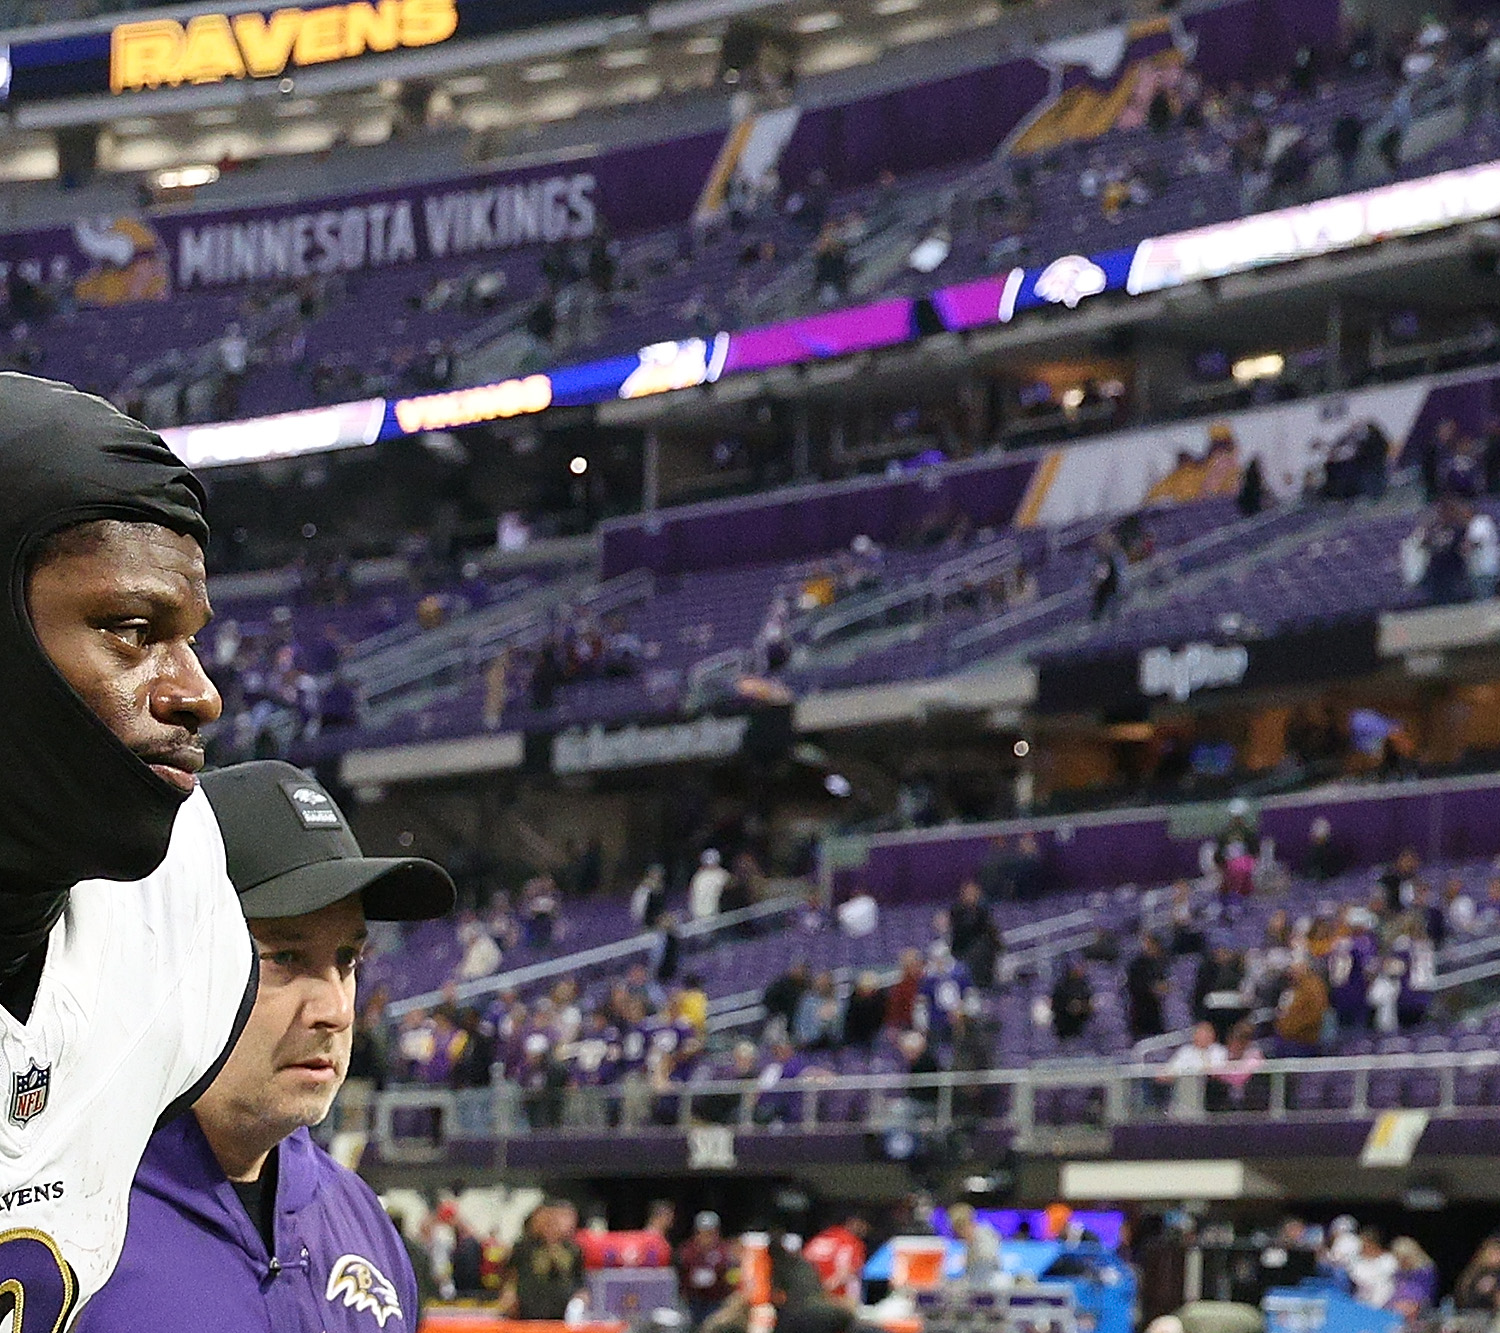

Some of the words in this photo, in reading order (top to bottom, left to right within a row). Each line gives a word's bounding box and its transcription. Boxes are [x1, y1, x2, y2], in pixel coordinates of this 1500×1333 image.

[110, 0, 459, 94] RAVENS
[177, 199, 418, 288] MINNESOTA
[424, 173, 599, 258] VIKINGS
[16, 1089, 43, 1118] NFL
